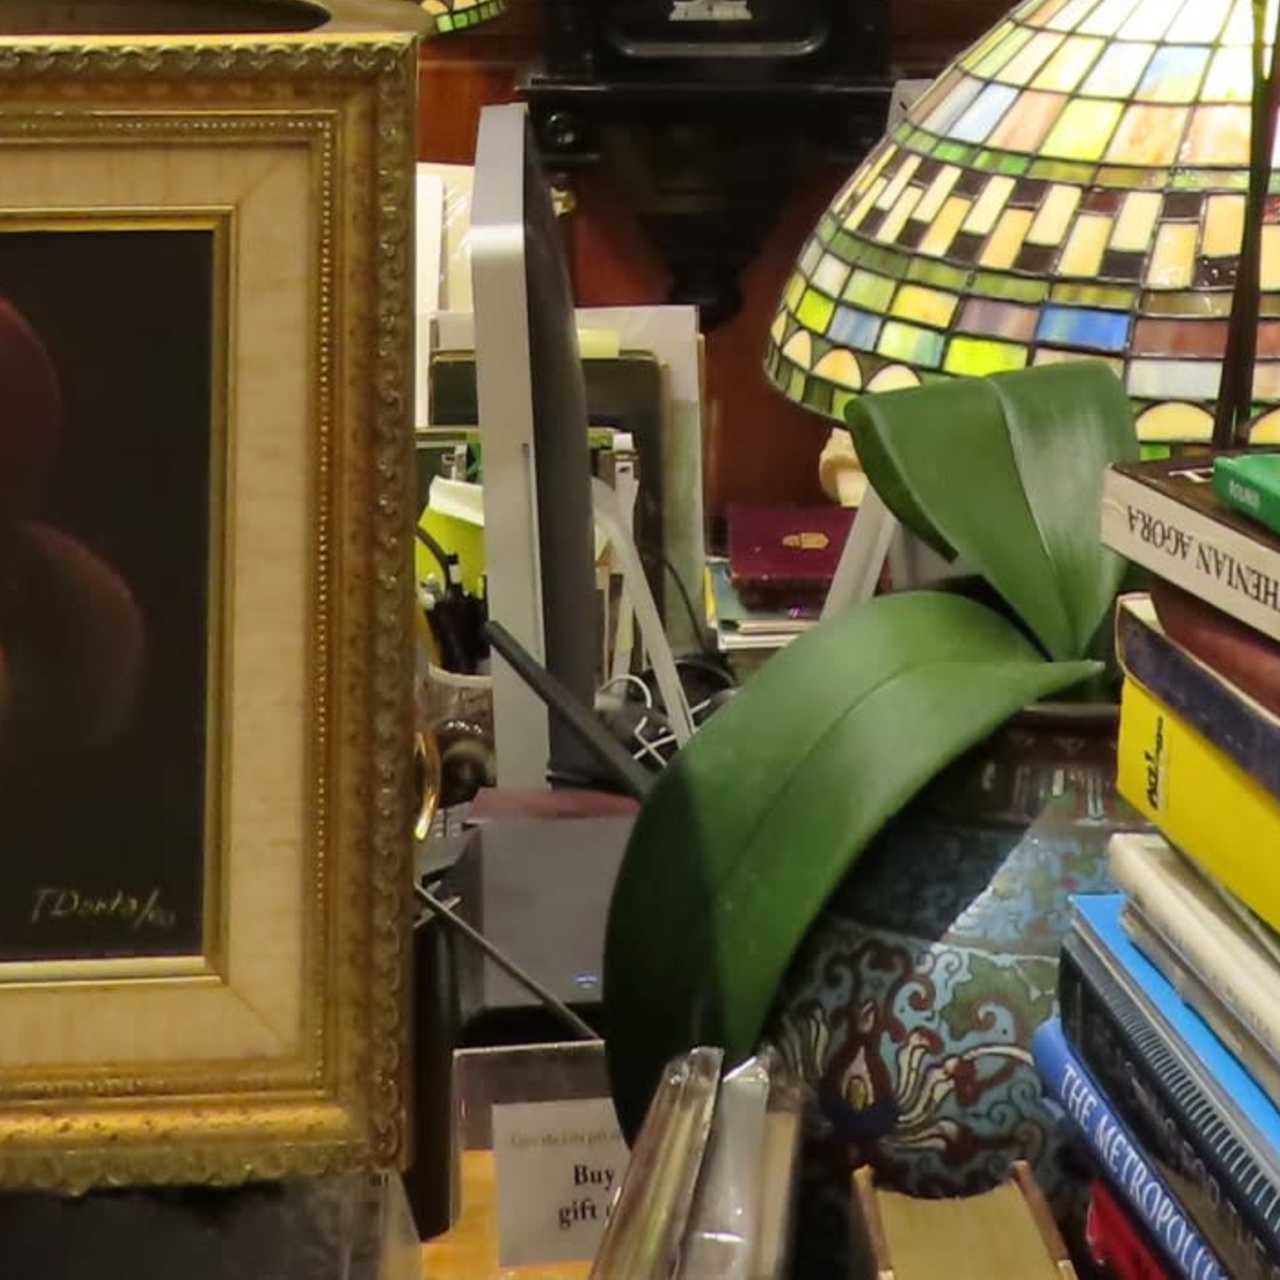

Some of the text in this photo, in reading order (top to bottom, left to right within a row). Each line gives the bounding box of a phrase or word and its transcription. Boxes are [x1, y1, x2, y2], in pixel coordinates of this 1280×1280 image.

[1126, 505, 1194, 559] AGORA
[1059, 1062, 1097, 1131] THE
[573, 1164, 615, 1190] Buy
[558, 1197, 597, 1231] gift
